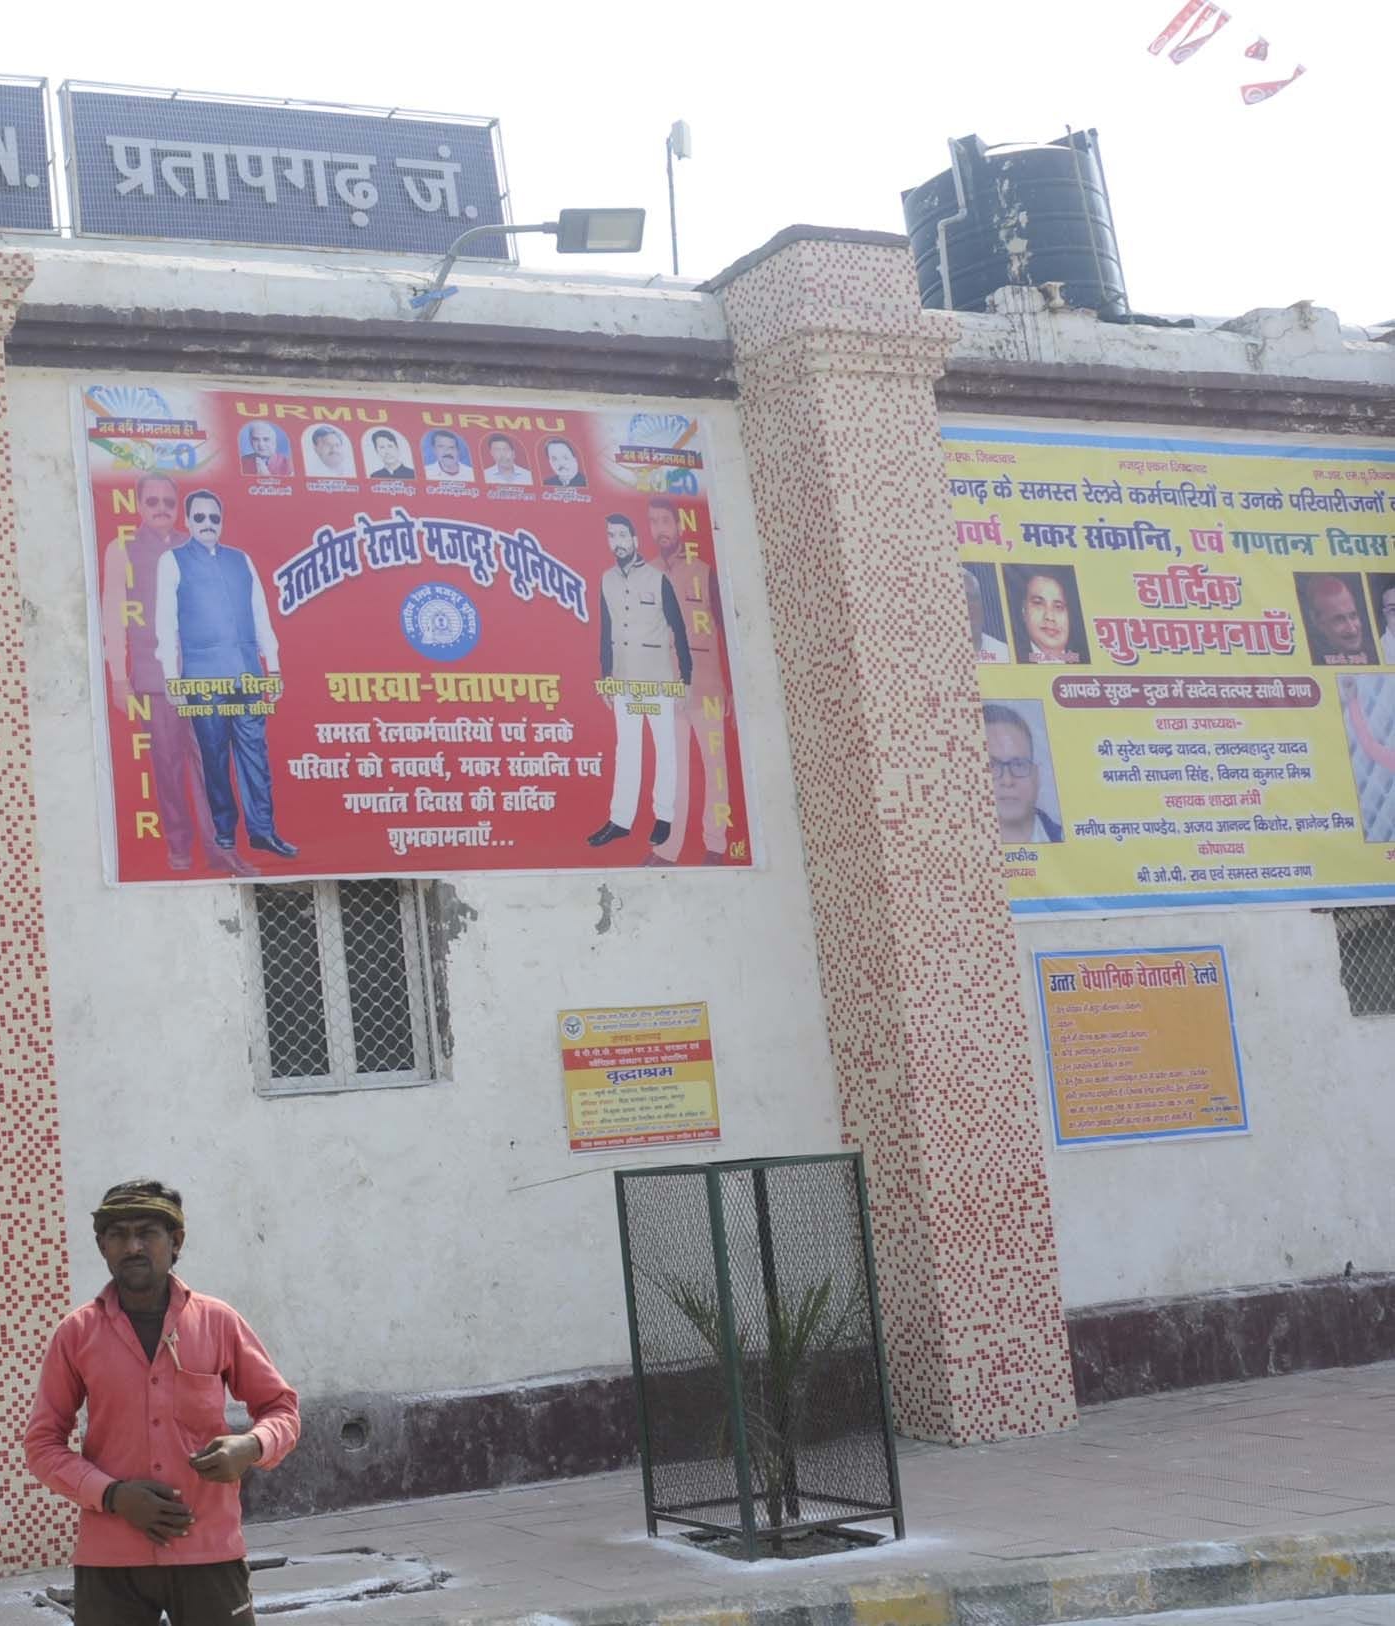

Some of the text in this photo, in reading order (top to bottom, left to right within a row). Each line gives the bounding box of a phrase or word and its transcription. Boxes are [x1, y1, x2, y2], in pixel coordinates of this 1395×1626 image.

[105, 134, 379, 228] प्रतापगढ़
[235, 401, 566, 432] URMU URMU
[991, 473, 1013, 499] के
[1018, 480, 1078, 501] समस्त
[1081, 477, 1123, 504] रेलवे
[1238, 487, 1284, 511] उनके
[1020, 523, 1078, 549] मकर
[1189, 522, 1225, 553] एवं
[1325, 527, 1389, 556] दिवस
[277, 509, 589, 622] उत्तरीय रेलवे मजदूर यूनियन
[1132, 563, 1241, 609] हार्दिक
[1059, 678, 1312, 706] आपके दुख में तत्पर साथी गण
[314, 722, 372, 745] समस्त
[499, 716, 527, 743] एवं
[531, 717, 574, 743] उनके
[1097, 739, 1114, 757] श्री
[1277, 741, 1308, 755] यादव
[355, 753, 384, 778] को
[458, 755, 502, 778] मकर
[575, 750, 604, 778] एवं
[1252, 766, 1285, 786] कुमार
[414, 786, 464, 814] दिवस
[468, 785, 495, 813] की
[501, 785, 557, 812] हार्दिक
[1109, 821, 1141, 842] कुमार
[1137, 865, 1153, 883] श्री
[1227, 867, 1259, 880] समस्त
[1049, 960, 1219, 993] उत्तर वैधानिक चेतावनी रेलवे
